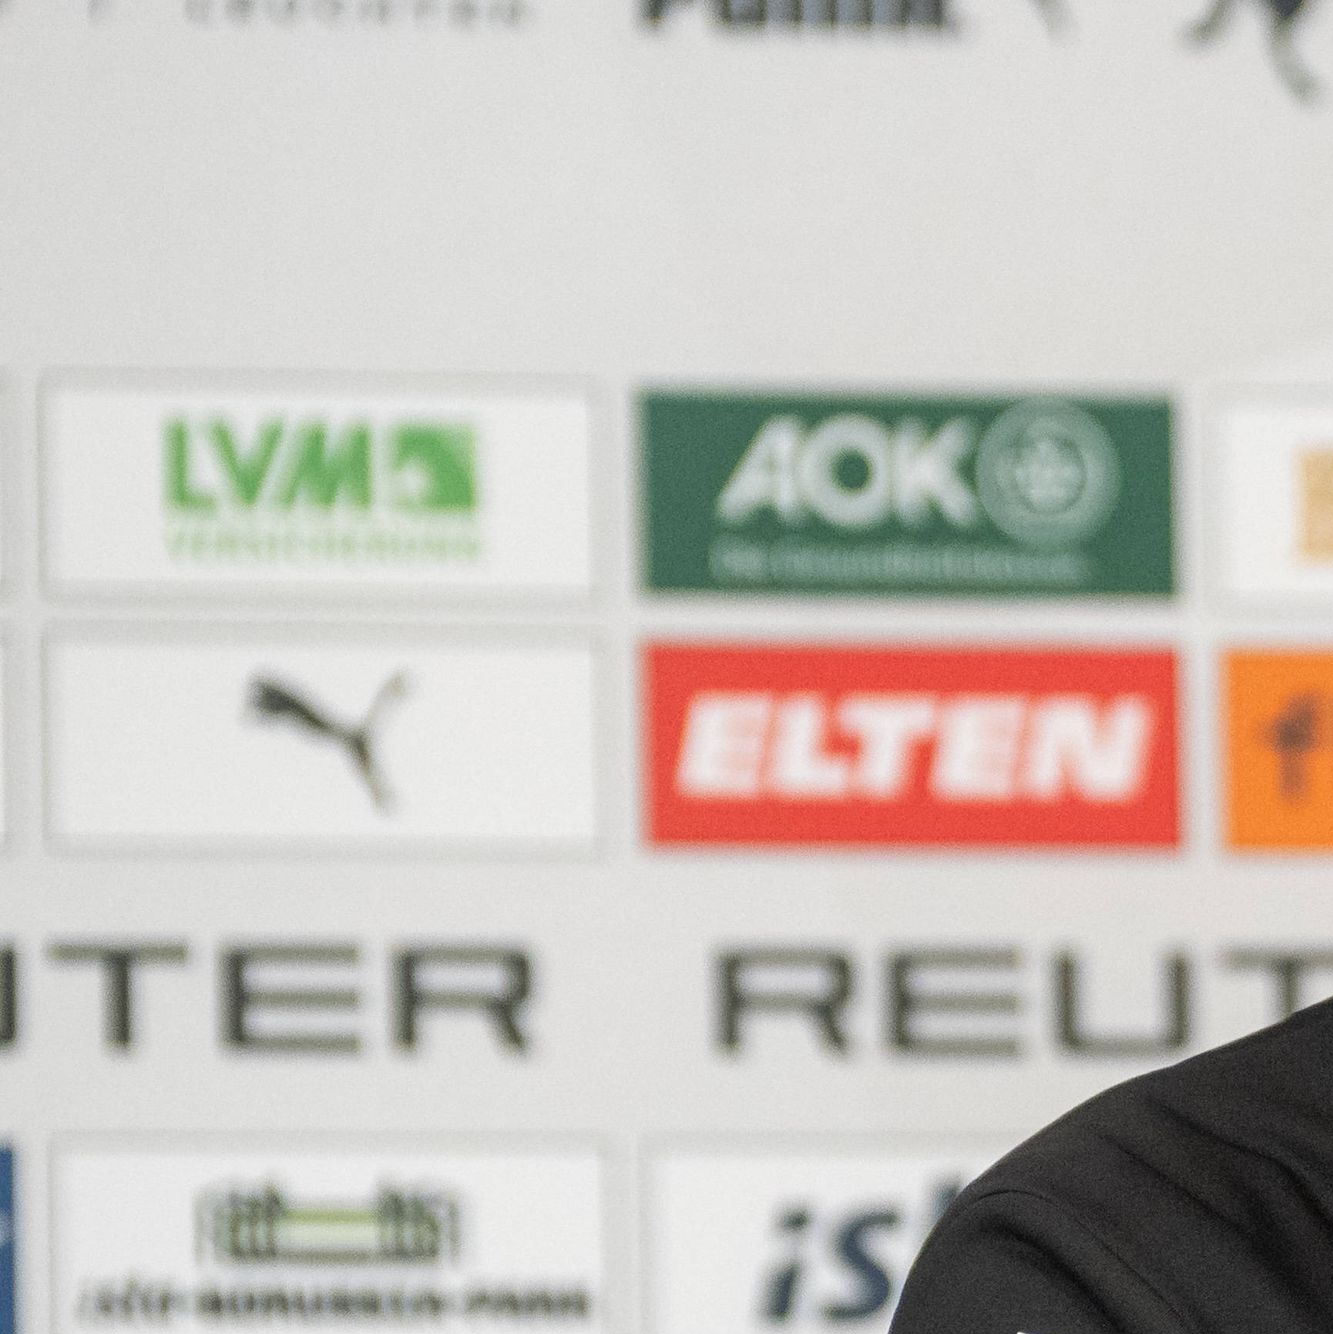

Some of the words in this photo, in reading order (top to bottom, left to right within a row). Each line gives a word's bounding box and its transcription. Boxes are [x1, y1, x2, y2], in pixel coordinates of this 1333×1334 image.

[160, 412, 376, 515] LVM
[712, 408, 978, 530] AOK
[675, 690, 1152, 802] ELTEN
[0, 940, 537, 1056] TER
